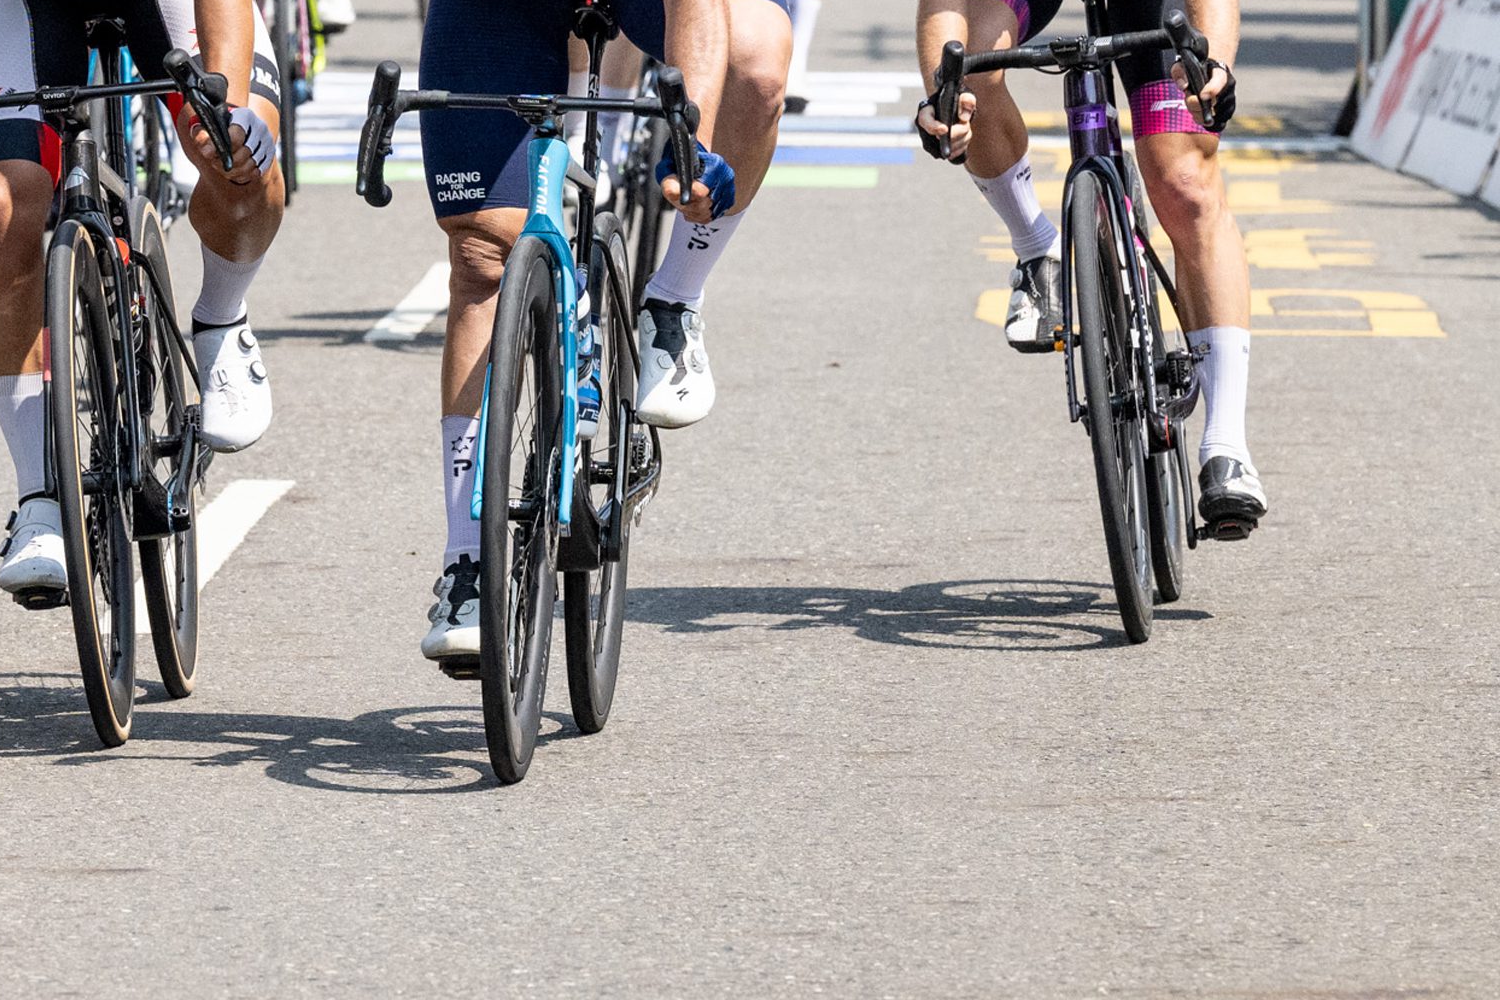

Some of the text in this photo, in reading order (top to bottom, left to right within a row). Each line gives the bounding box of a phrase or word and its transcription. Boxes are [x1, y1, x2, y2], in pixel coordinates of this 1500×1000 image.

[436, 171, 481, 186] RACING
[535, 154, 550, 215] FACTOR
[437, 188, 486, 202] CHANGE
